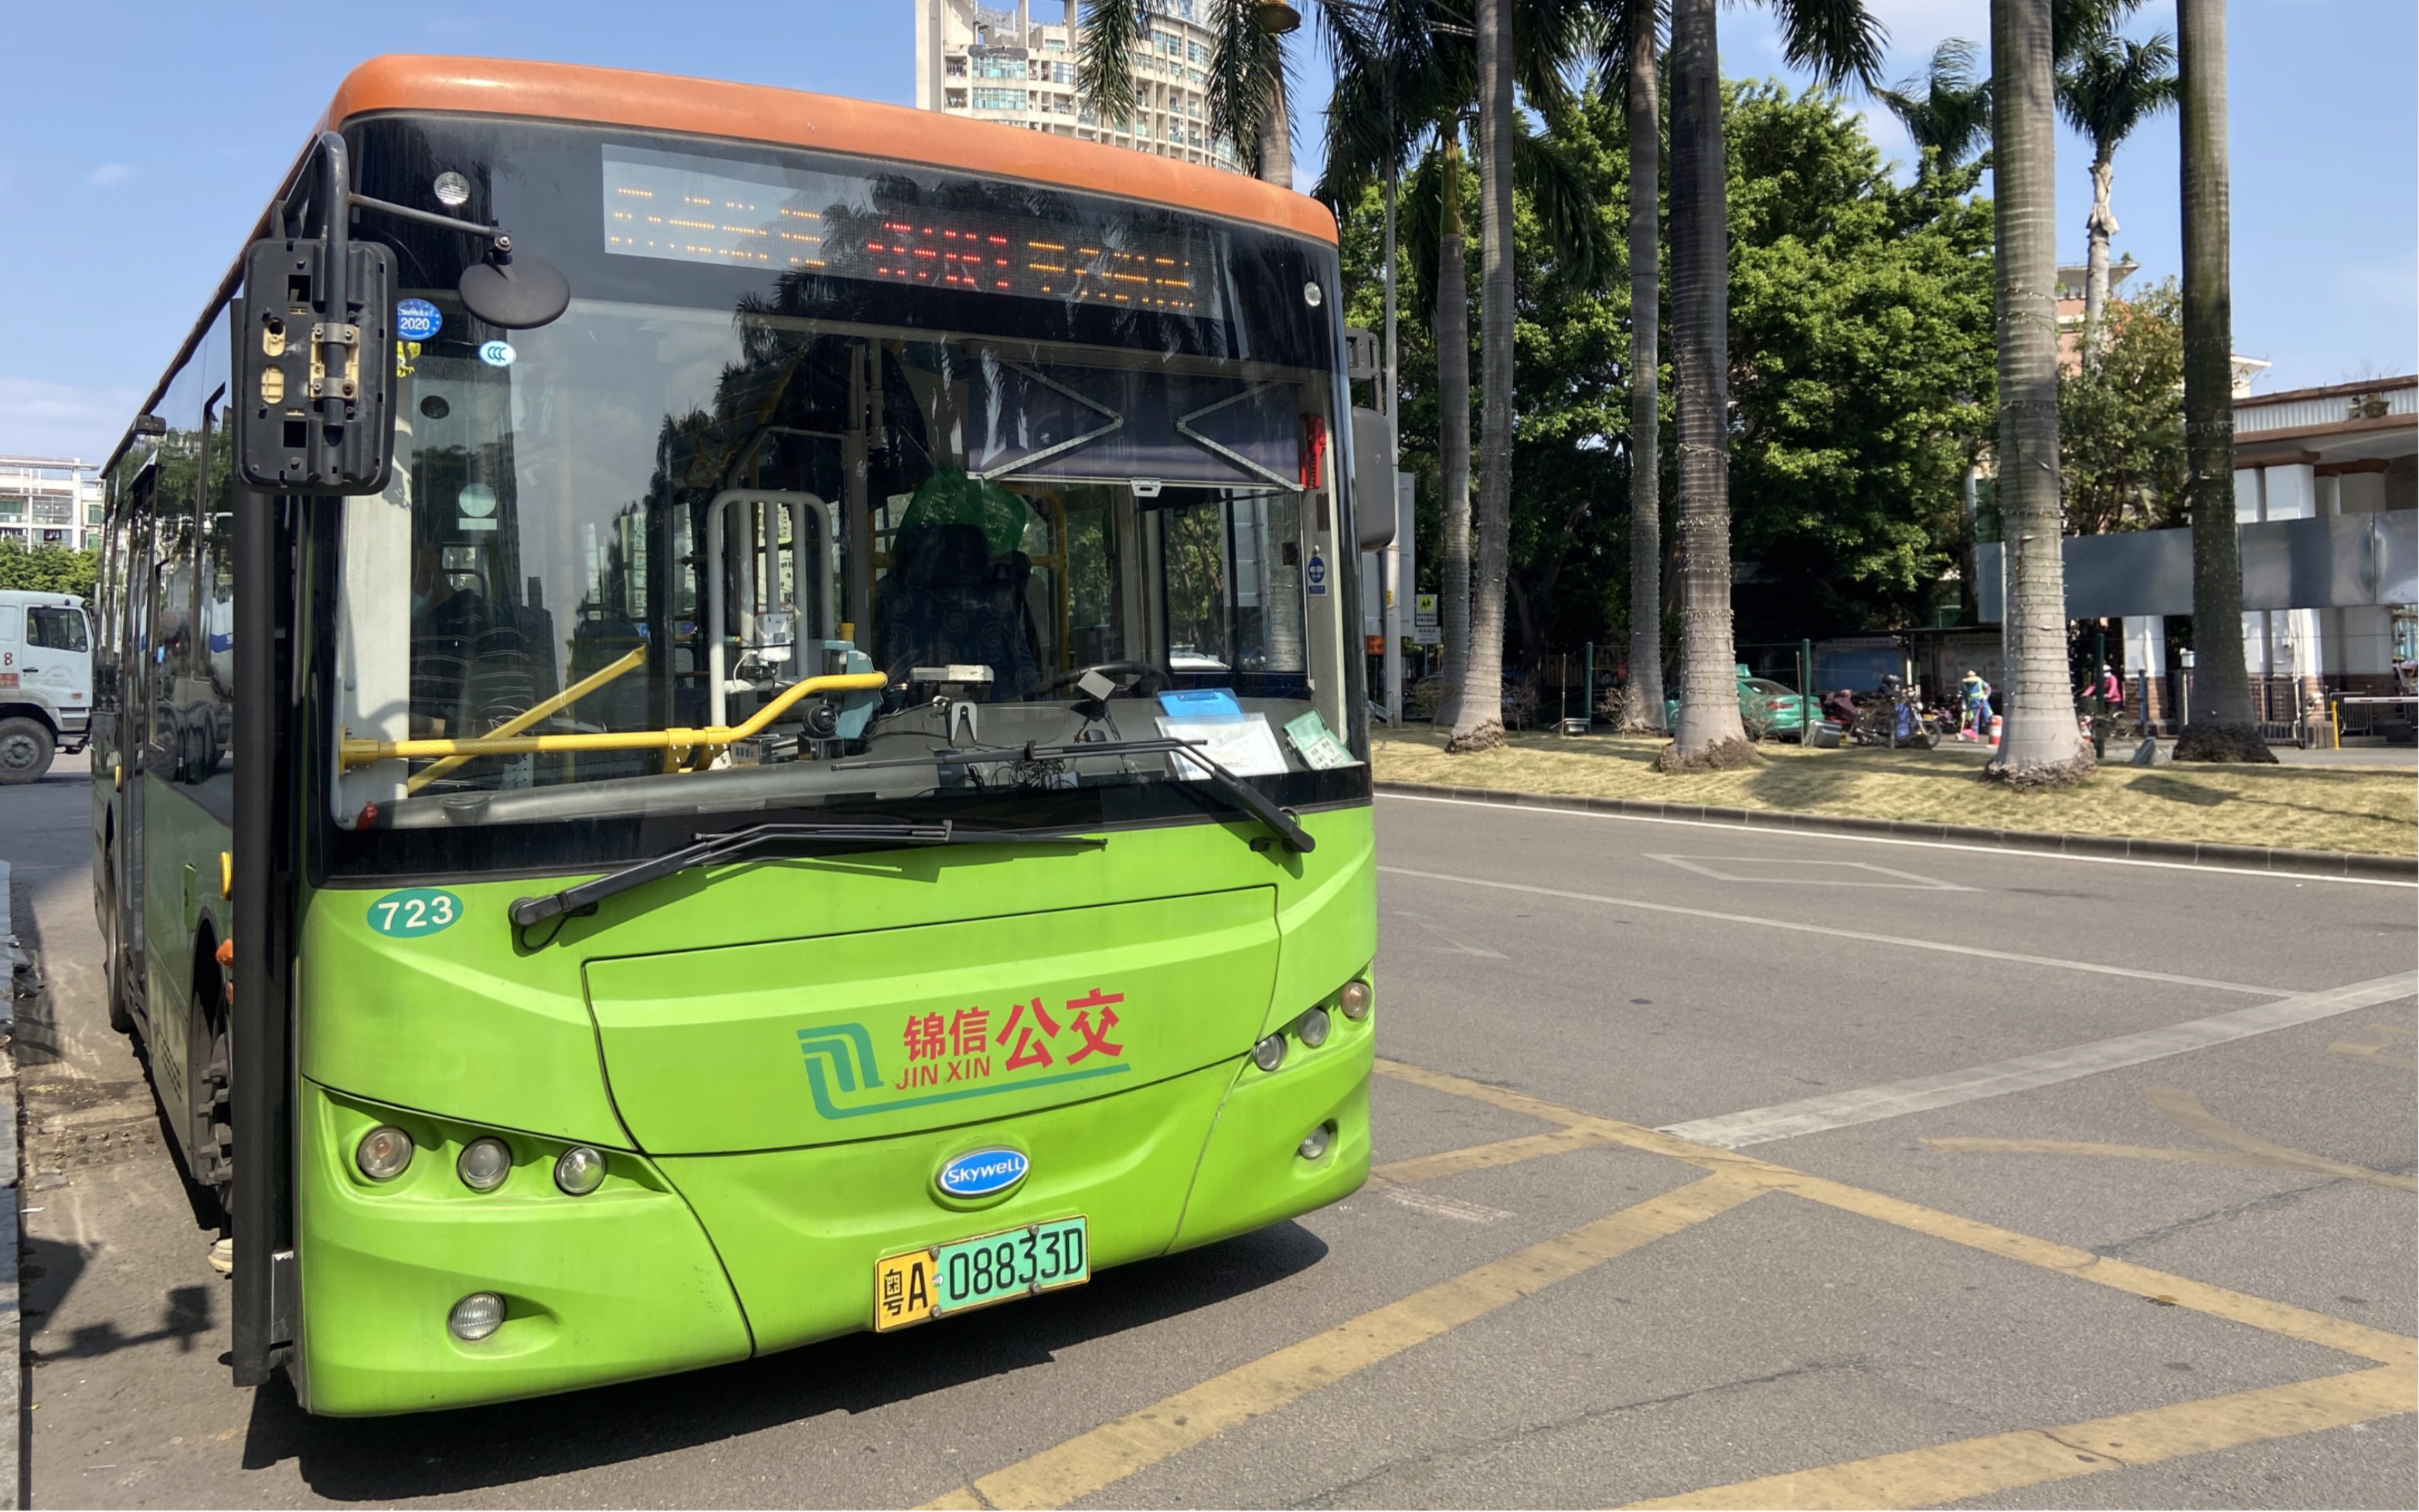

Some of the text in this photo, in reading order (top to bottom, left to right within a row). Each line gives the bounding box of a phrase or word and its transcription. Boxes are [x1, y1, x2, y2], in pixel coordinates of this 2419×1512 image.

[400, 317, 430, 331] 2020
[378, 895, 454, 931] 723
[903, 987, 1124, 1072] 锦信公交
[895, 1055, 991, 1091] JIN XIN
[947, 1157, 1023, 1185] Skywell
[883, 1227, 1084, 1317] 粤A 08833D
